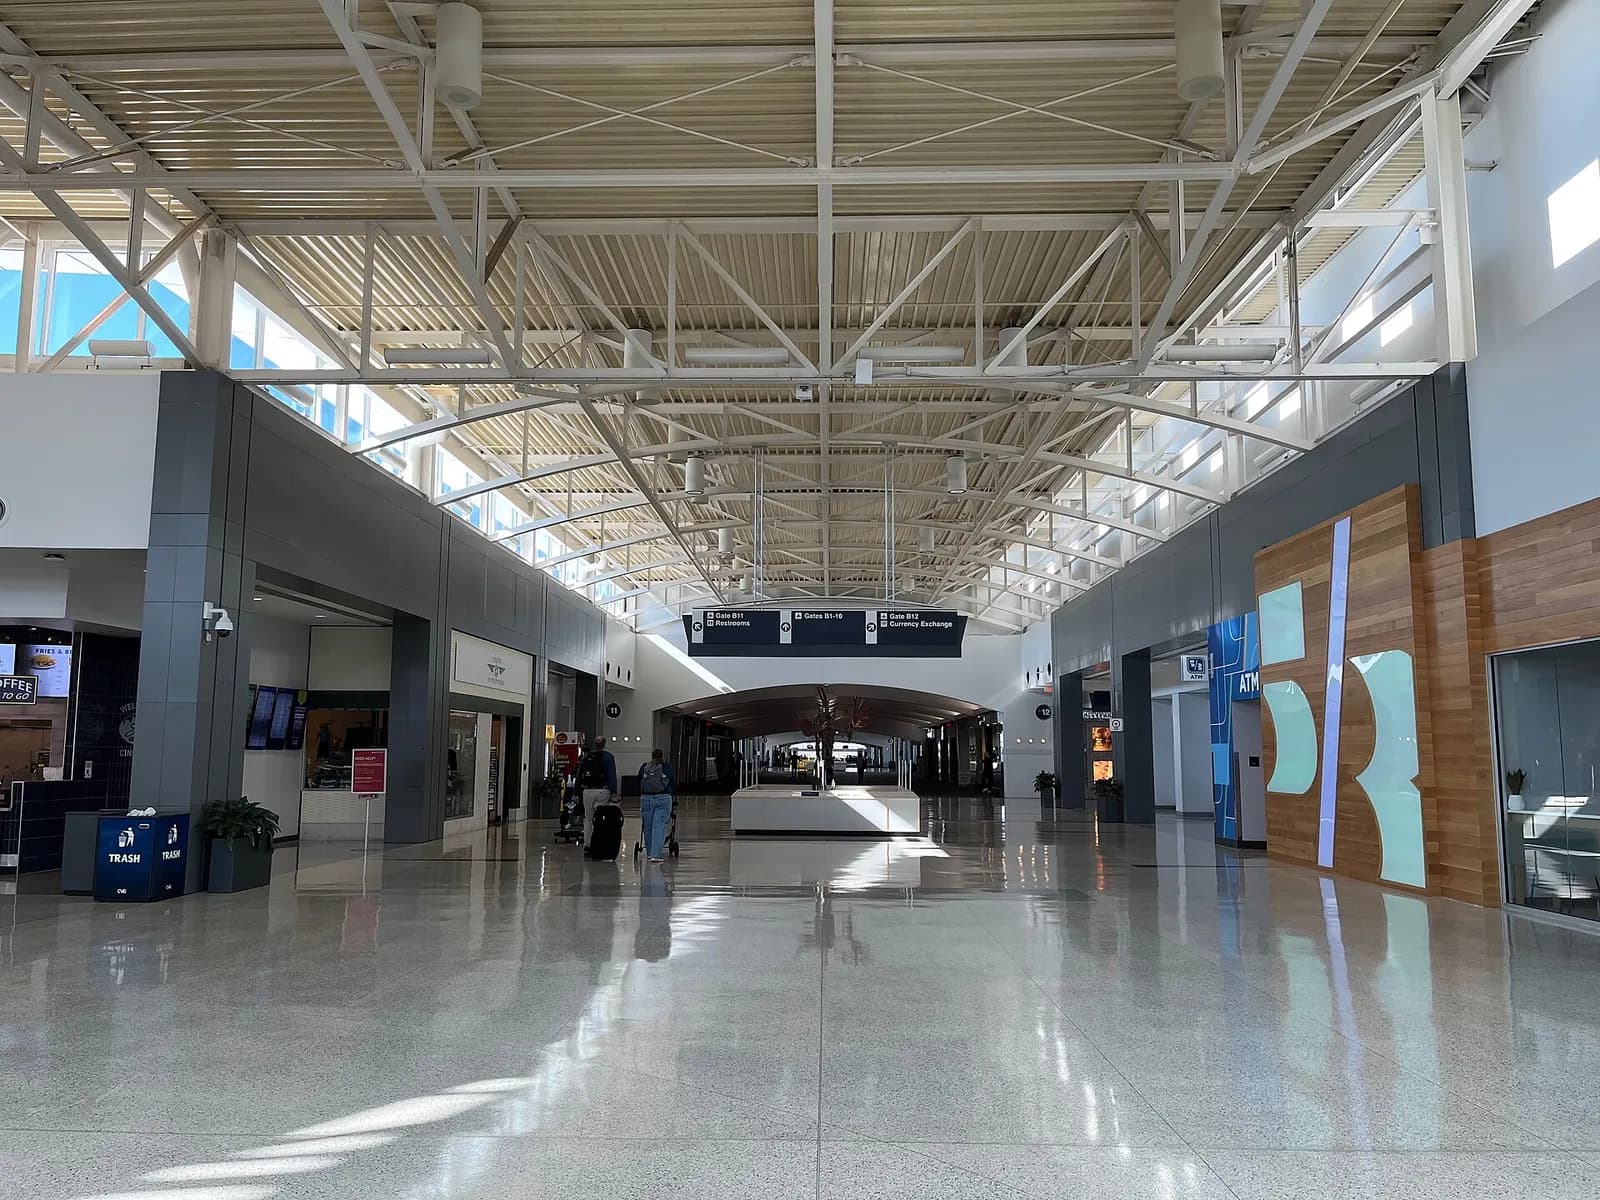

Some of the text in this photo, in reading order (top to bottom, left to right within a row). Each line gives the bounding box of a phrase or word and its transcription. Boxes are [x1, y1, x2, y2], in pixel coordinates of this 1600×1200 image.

[889, 621, 953, 629] Currency Exchange
[1239, 671, 1259, 694] ATM
[2, 692, 30, 700] TO GO
[108, 853, 141, 864] TRASH
[162, 849, 181, 860] TRASH
